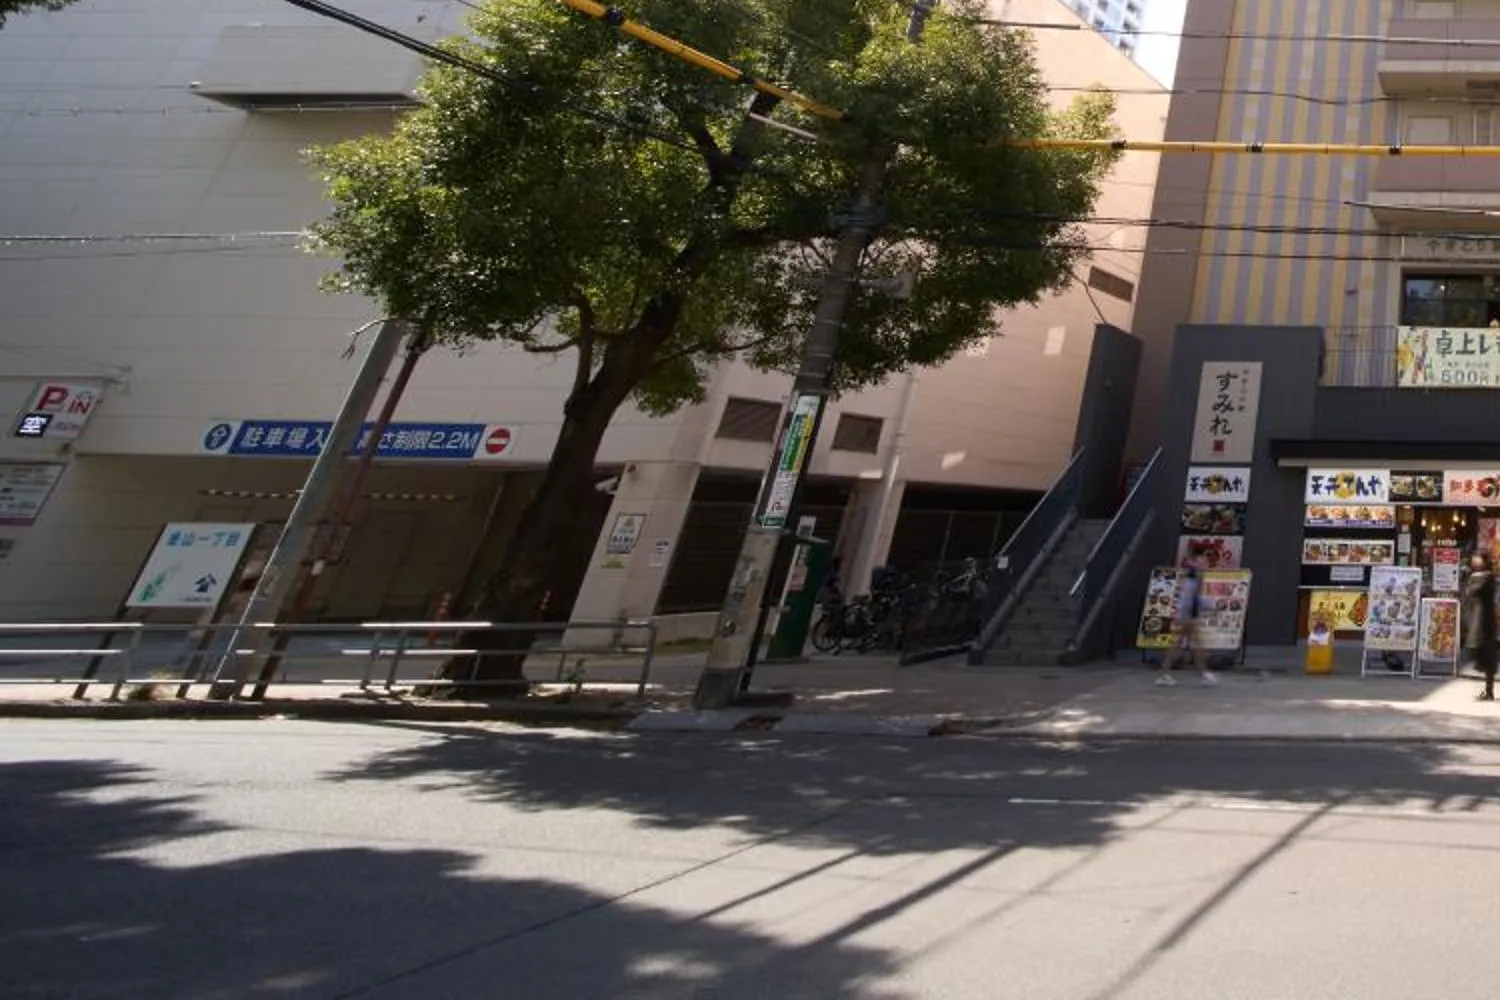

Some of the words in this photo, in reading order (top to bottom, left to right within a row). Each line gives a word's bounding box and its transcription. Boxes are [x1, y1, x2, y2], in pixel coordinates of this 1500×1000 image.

[36, 385, 69, 411] P
[68, 401, 91, 415] IN
[1209, 369, 1239, 436] すみれ
[19, 416, 47, 434] 空
[243, 427, 330, 449] 駐車場入
